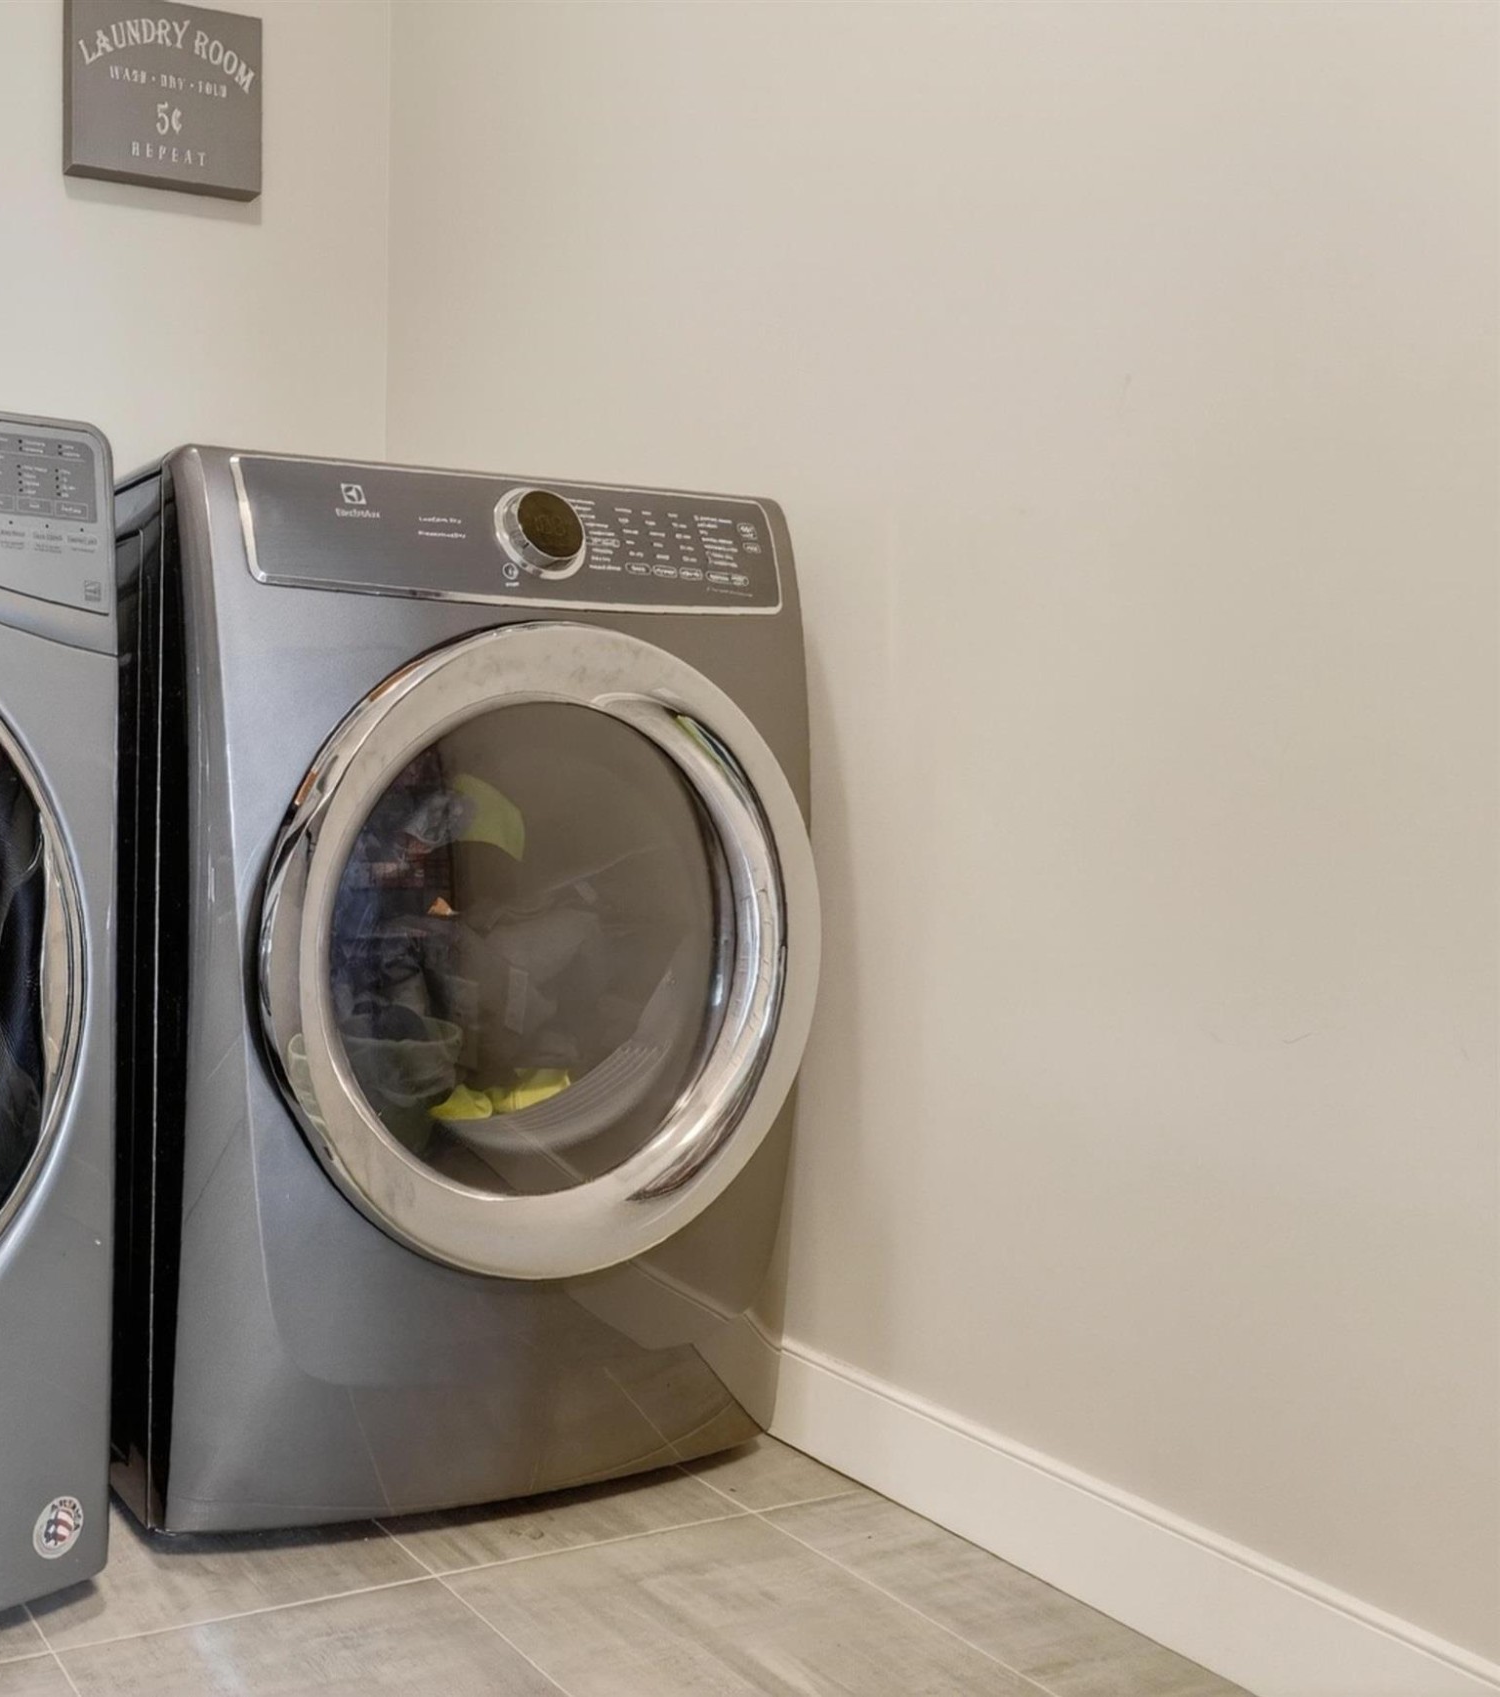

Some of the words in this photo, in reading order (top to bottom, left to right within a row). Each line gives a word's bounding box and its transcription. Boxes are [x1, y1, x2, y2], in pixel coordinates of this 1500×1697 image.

[78, 18, 191, 65] LAUNDRY
[194, 30, 255, 94] ROOM
[109, 65, 147, 84] WASH
[160, 74, 186, 91] DRY
[198, 81, 228, 98] FOLD
[156, 102, 183, 135] 5¢
[131, 141, 206, 167] REPEAT
